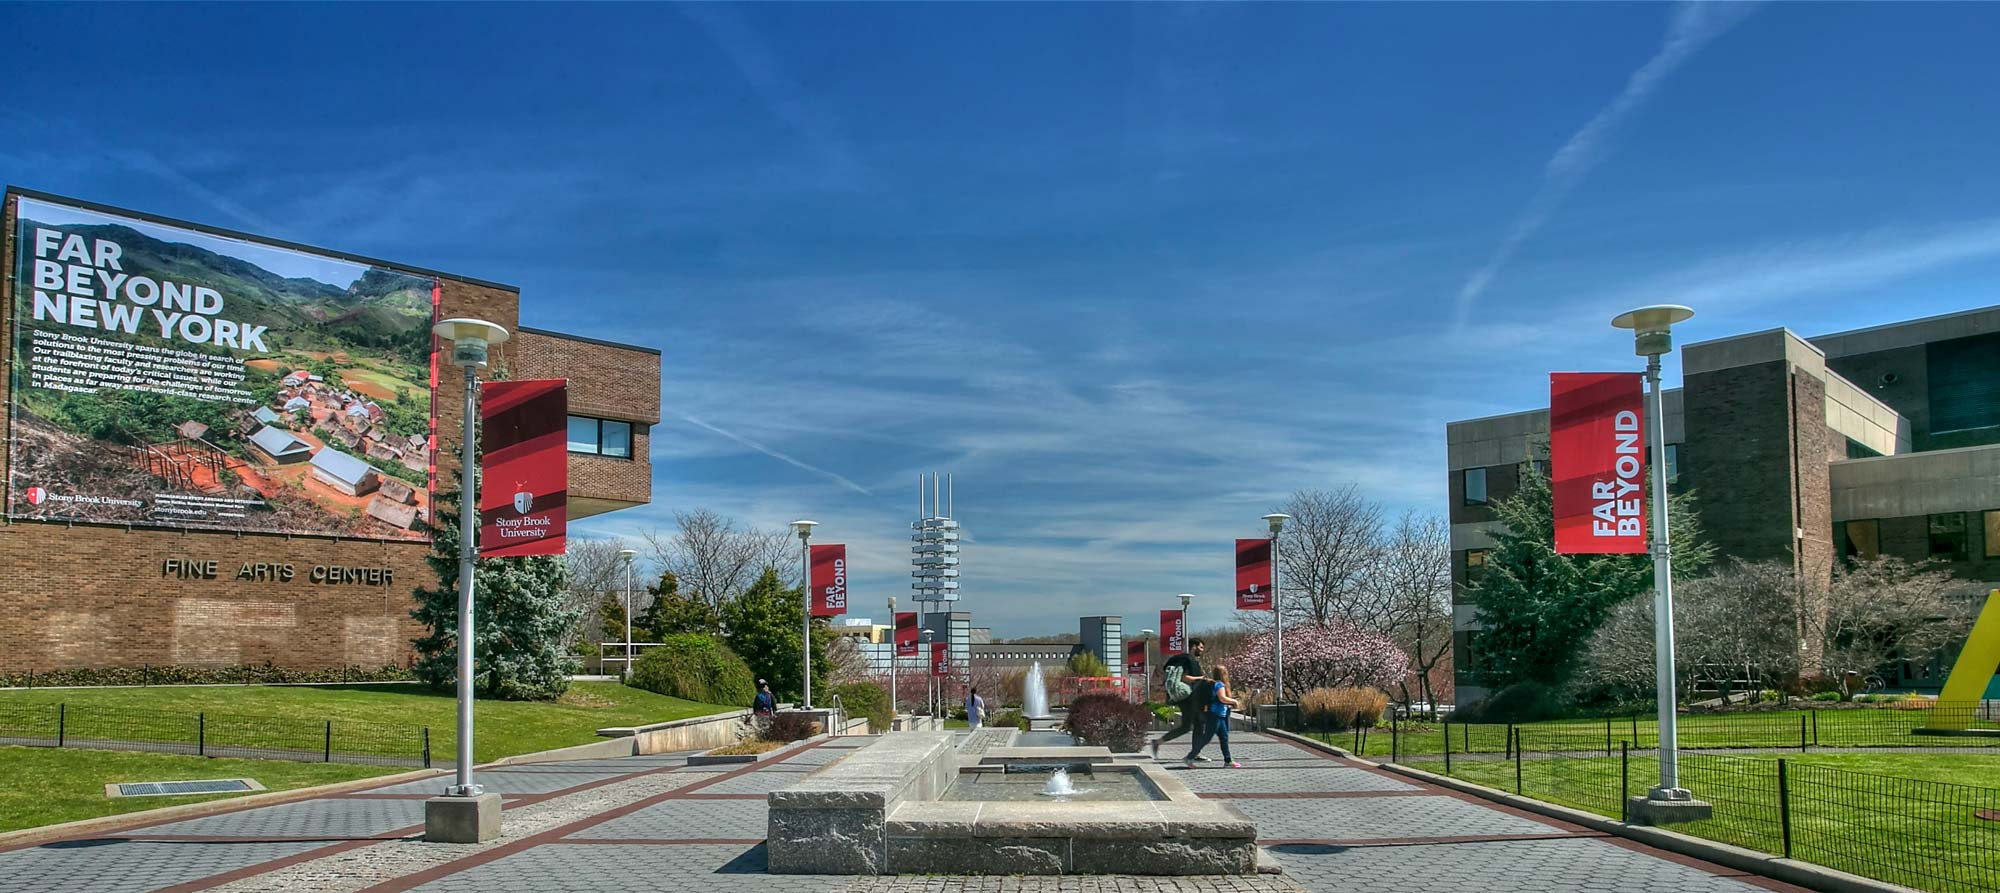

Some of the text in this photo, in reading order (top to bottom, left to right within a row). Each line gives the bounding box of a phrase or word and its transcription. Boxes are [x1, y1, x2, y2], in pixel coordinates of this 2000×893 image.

[35, 227, 123, 271] FAR
[33, 258, 224, 316] BEYOND
[33, 290, 269, 353] NEW YORK
[33, 329, 60, 340] Stony
[61, 333, 89, 343] Brook
[90, 337, 134, 350] University
[135, 344, 160, 353] spans
[161, 347, 175, 355] the
[175, 350, 198, 358] globe
[199, 352, 208, 360] in
[208, 355, 234, 364] search
[33, 339, 75, 350] solutions
[87, 345, 102, 353] the
[103, 348, 125, 356] most
[126, 351, 162, 362] pressing
[163, 357, 201, 366] problems
[226, 364, 246, 372] time.
[33, 346, 51, 354] Our
[52, 349, 102, 362] trailblazing
[104, 356, 134, 366] faculty
[152, 363, 198, 374] researchers
[213, 371, 246, 381] working
[59, 358, 99, 369] forefront
[111, 365, 142, 375] today's
[142, 370, 172, 379] critical
[200, 377, 222, 385] while
[31, 380, 98, 394] in Madagascar.
[32, 364, 71, 374] students
[88, 371, 131, 383] preparing
[132, 376, 145, 384] for
[161, 380, 203, 391] challenges
[214, 386, 253, 396] tomorrow
[32, 371, 42, 379] in
[43, 373, 73, 383] places
[85, 378, 99, 386] far
[98, 381, 123, 390] away
[151, 387, 197, 398] world-class
[198, 393, 231, 401] research
[1614, 410, 1641, 537] BEYOND
[49, 492, 143, 507] Stony Brook University
[154, 507, 207, 515] stonybrook.edu
[1592, 481, 1616, 537] FAR
[496, 516, 551, 528] Stony Brook
[500, 527, 547, 538] University
[165, 558, 394, 583] FINE ARTS CENTER
[834, 558, 845, 608] BEYOND
[826, 586, 835, 609] FAR
